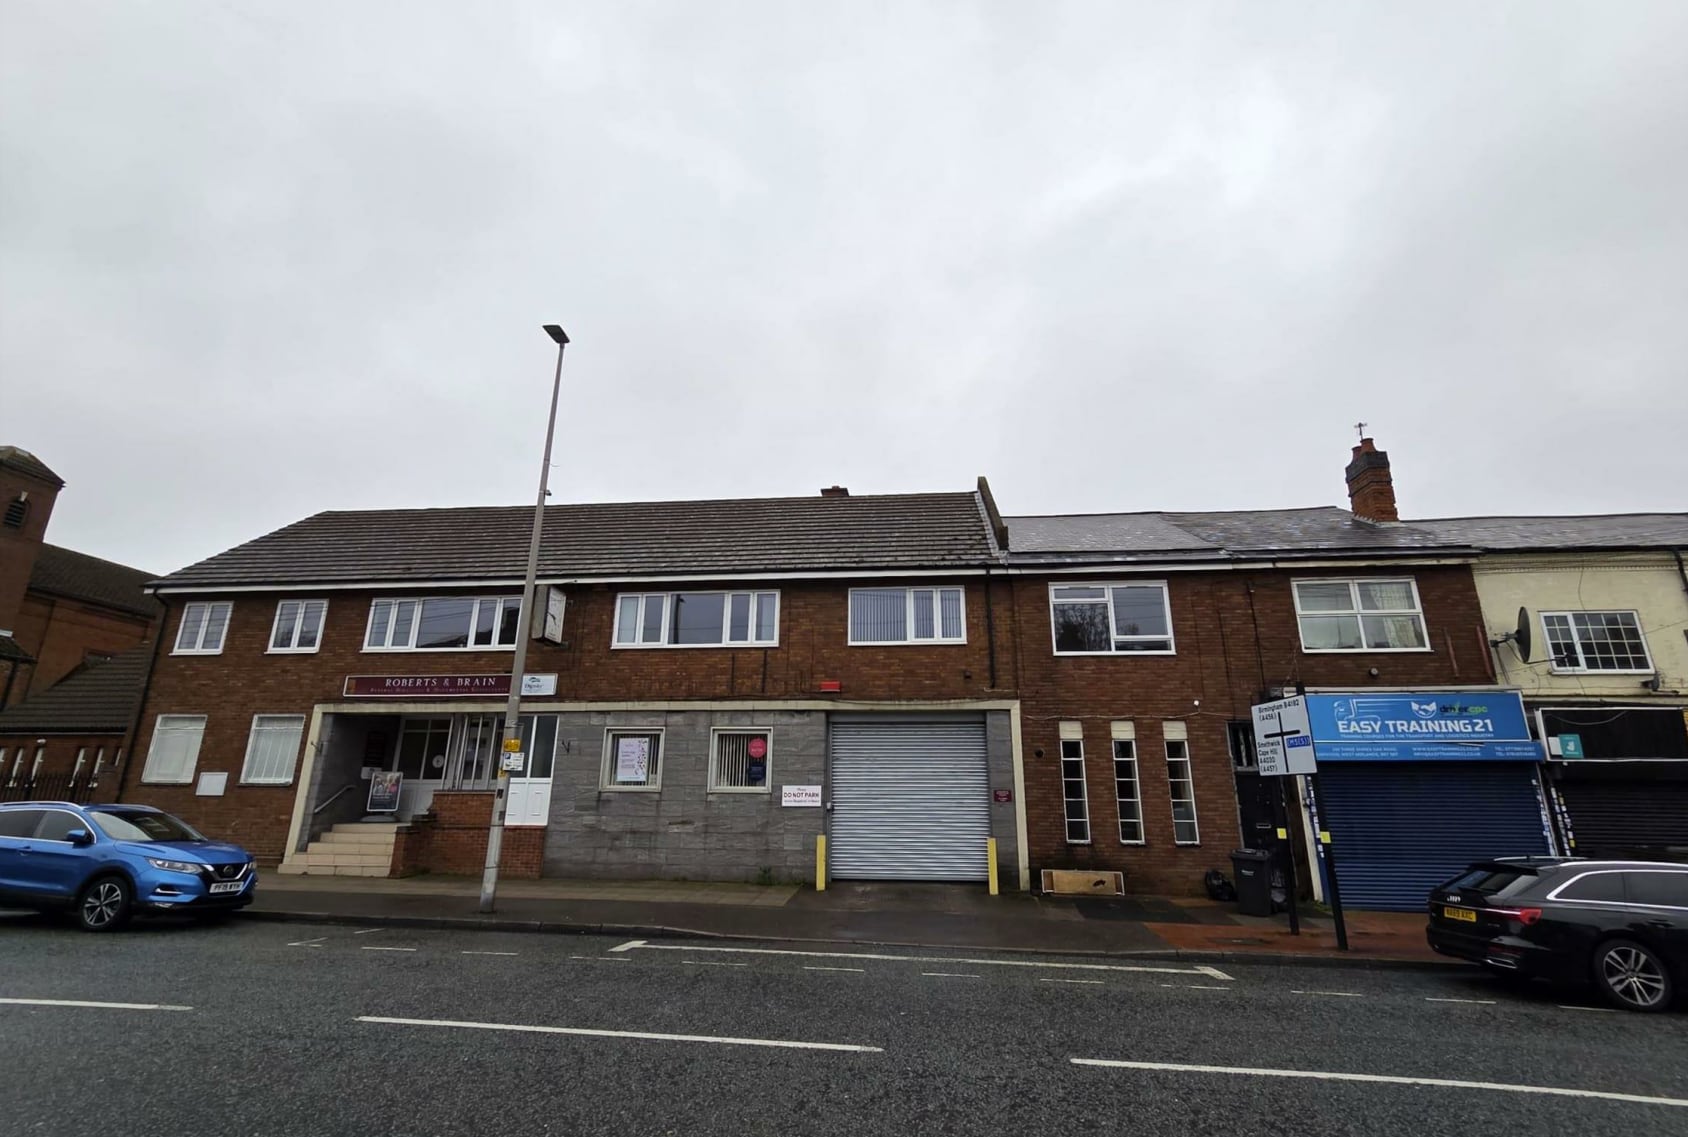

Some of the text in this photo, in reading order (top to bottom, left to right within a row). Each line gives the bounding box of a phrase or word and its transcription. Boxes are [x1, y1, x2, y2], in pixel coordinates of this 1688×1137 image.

[385, 677, 497, 687] ROBERTS & BRAIN
[1258, 703, 1284, 713] Birmingham
[1337, 720, 1381, 733] EASY
[1257, 740, 1281, 748] Smethwick
[1258, 749, 1269, 757] Cape
